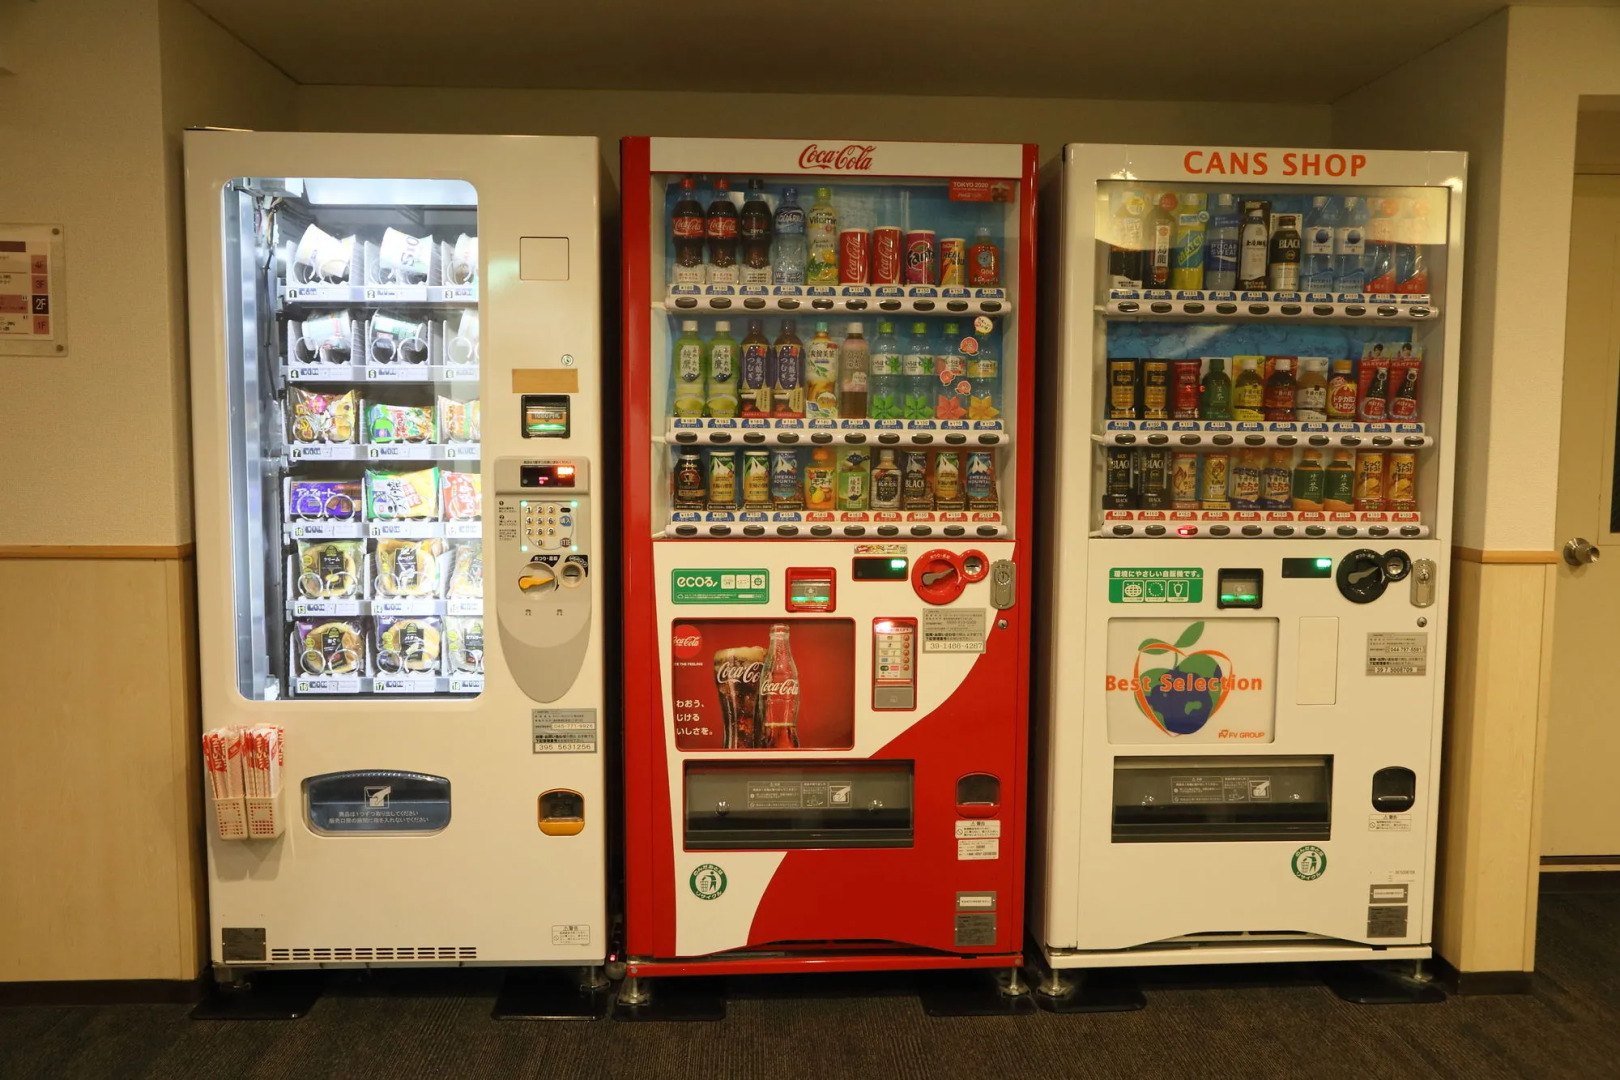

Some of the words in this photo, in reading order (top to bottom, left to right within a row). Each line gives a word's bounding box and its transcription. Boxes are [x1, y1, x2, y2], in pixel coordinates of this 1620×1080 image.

[798, 143, 877, 170] Coca-Cola
[1183, 150, 1268, 176] CANS
[1282, 152, 1368, 178] SHOP
[674, 218, 702, 232] Coca-Cola
[708, 218, 736, 232] Coca-Cola
[846, 236, 860, 280] Coca-Cola
[878, 236, 892, 280] Coca-Cola
[36, 280, 44, 288] 3F
[36, 299, 46, 310] 2F
[37, 322, 46, 330] 1F
[747, 357, 755, 381] つむぎ
[780, 357, 788, 381] つむぎ
[1114, 569, 1200, 578] 環境にやさしい自販機です。
[717, 661, 763, 684] Coca-Co
[760, 678, 798, 695] Coca-Cola
[1106, 674, 1151, 692] Best
[1159, 673, 1262, 692] Selection
[676, 713, 700, 722] じける
[676, 727, 713, 736] いしさを。
[1295, 870, 1322, 881] リサイクル
[695, 890, 723, 901] リサイクル
